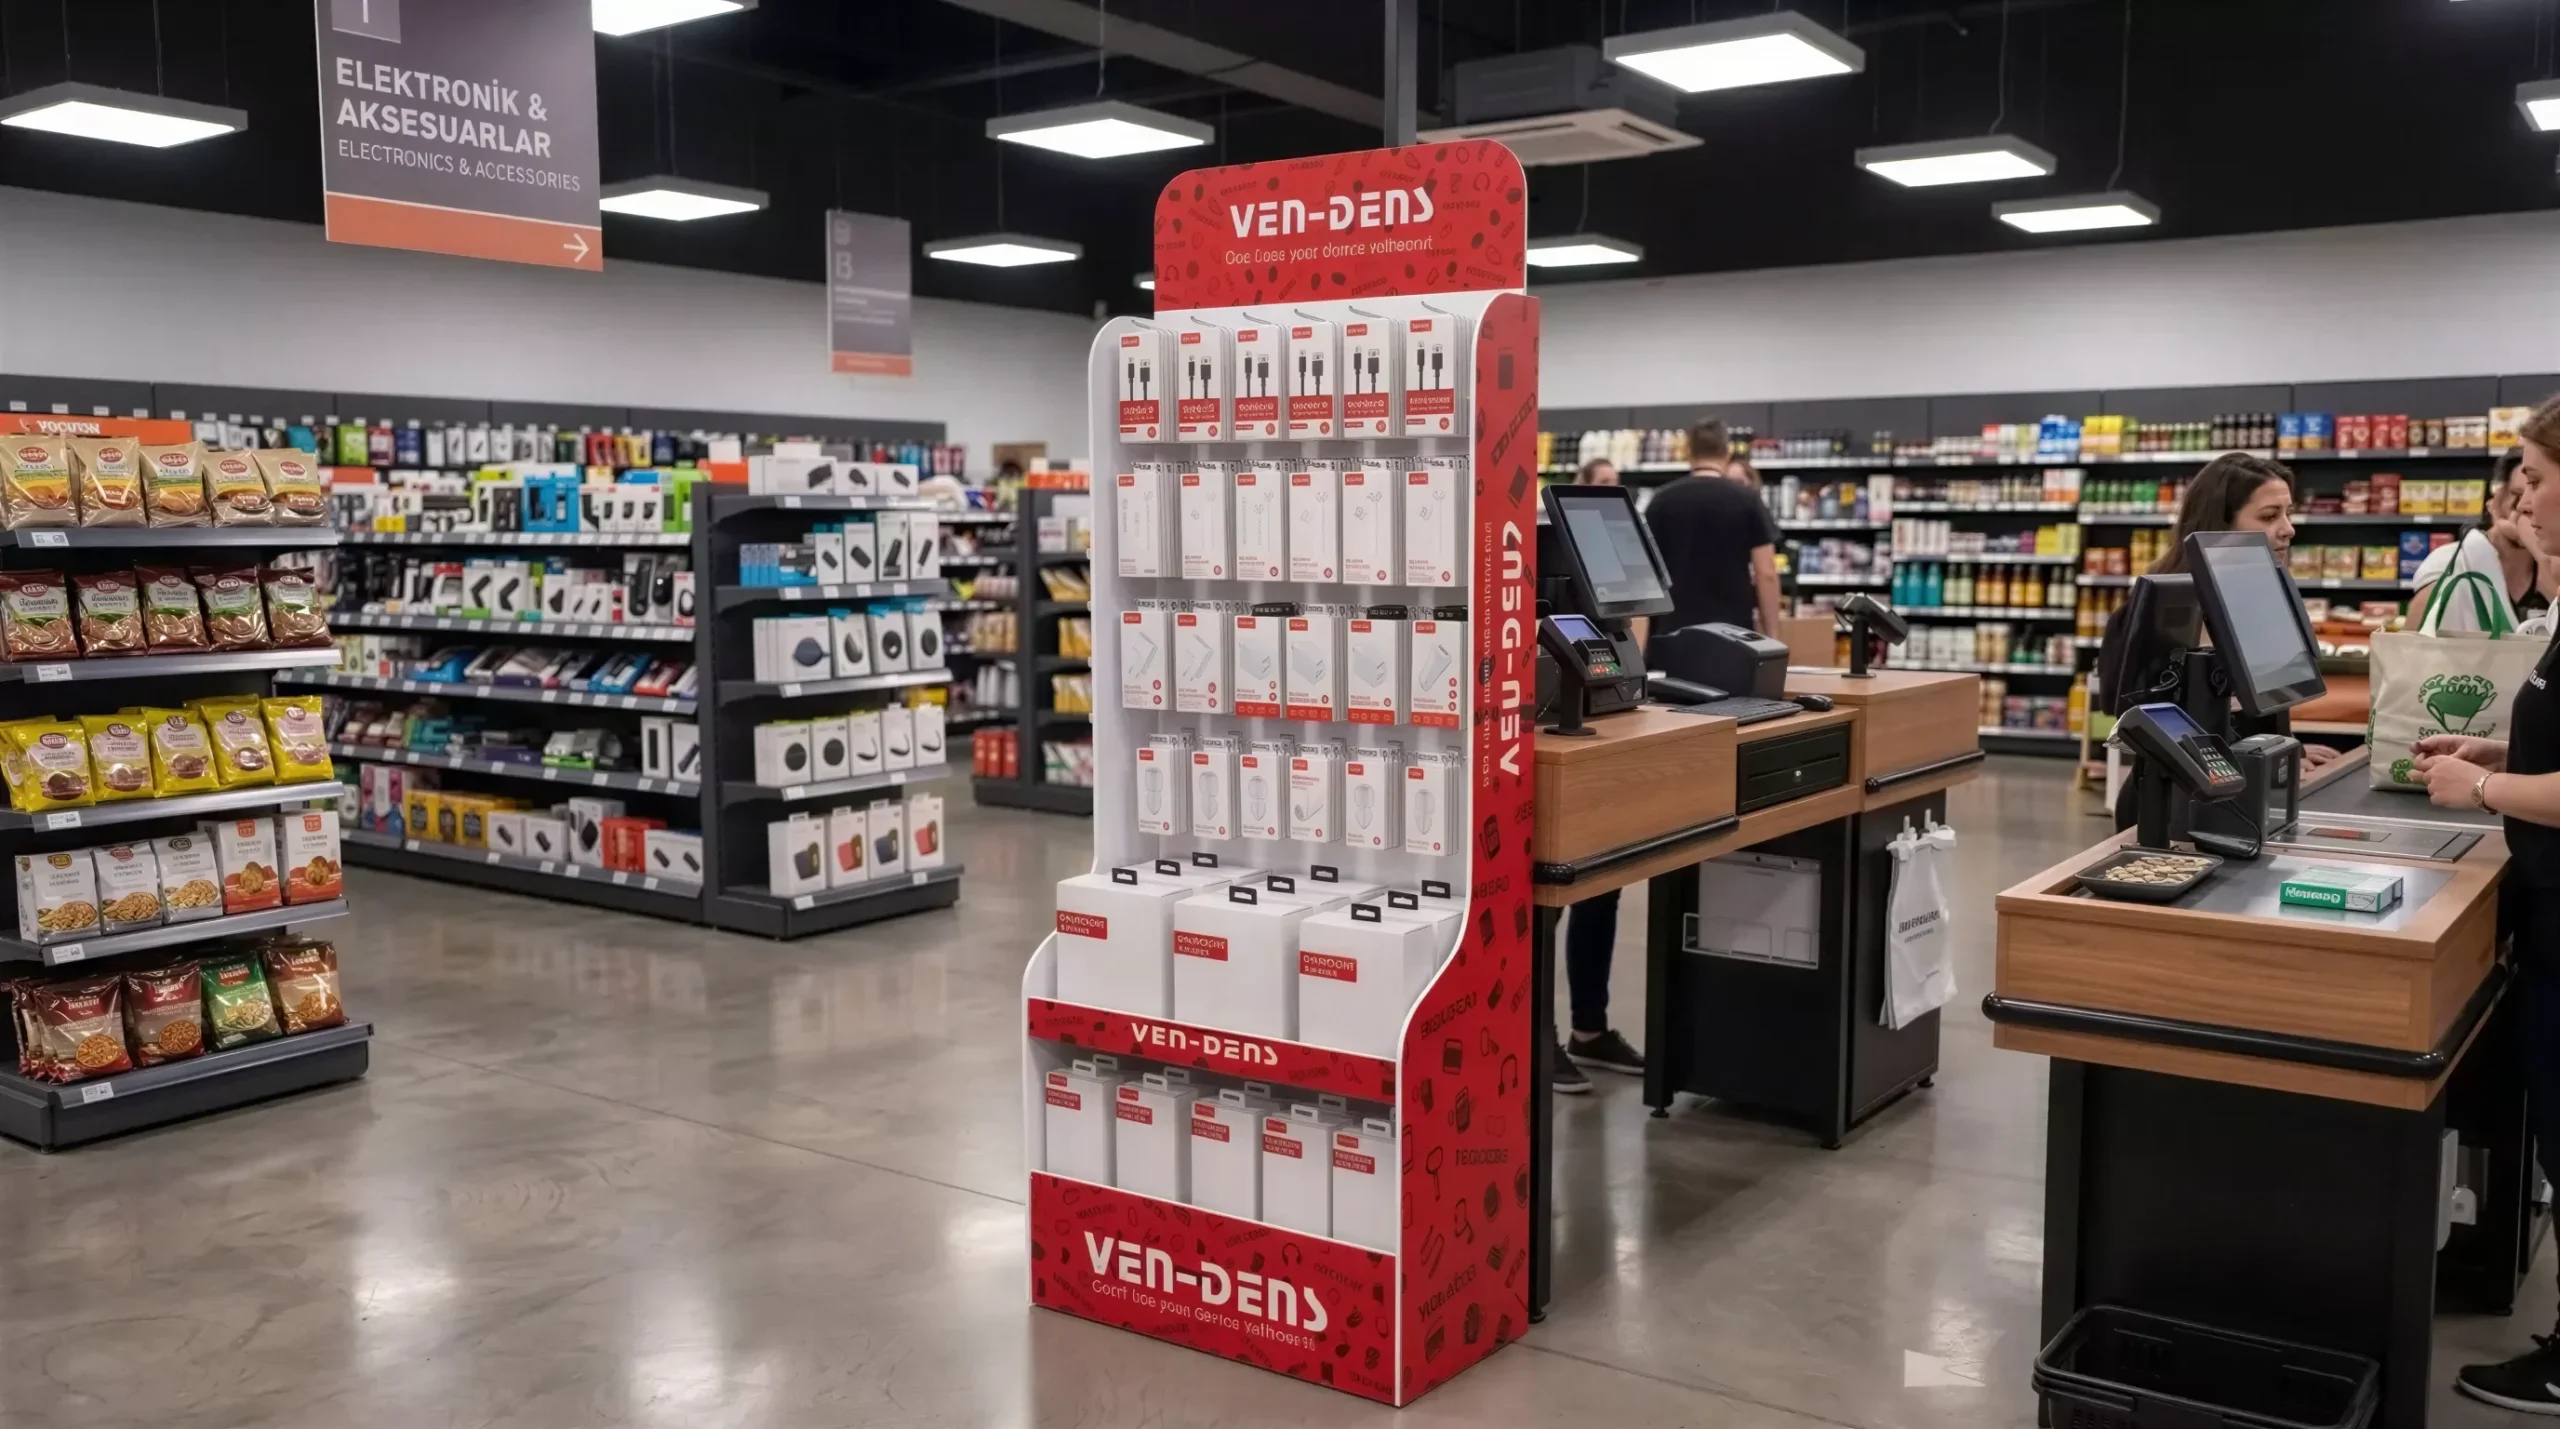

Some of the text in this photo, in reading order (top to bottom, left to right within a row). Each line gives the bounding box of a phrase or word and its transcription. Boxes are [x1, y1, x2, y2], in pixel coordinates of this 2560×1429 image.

[336, 98, 551, 158] AKSESUARLAR
[528, 93, 548, 122] &
[338, 139, 580, 192] ELECTRONICS & ACCESSORIES
[1229, 186, 1435, 239] VEN-DENS
[1131, 1022, 1278, 1066] VEN-DENS
[1084, 1230, 1329, 1333] VEN-DENS
